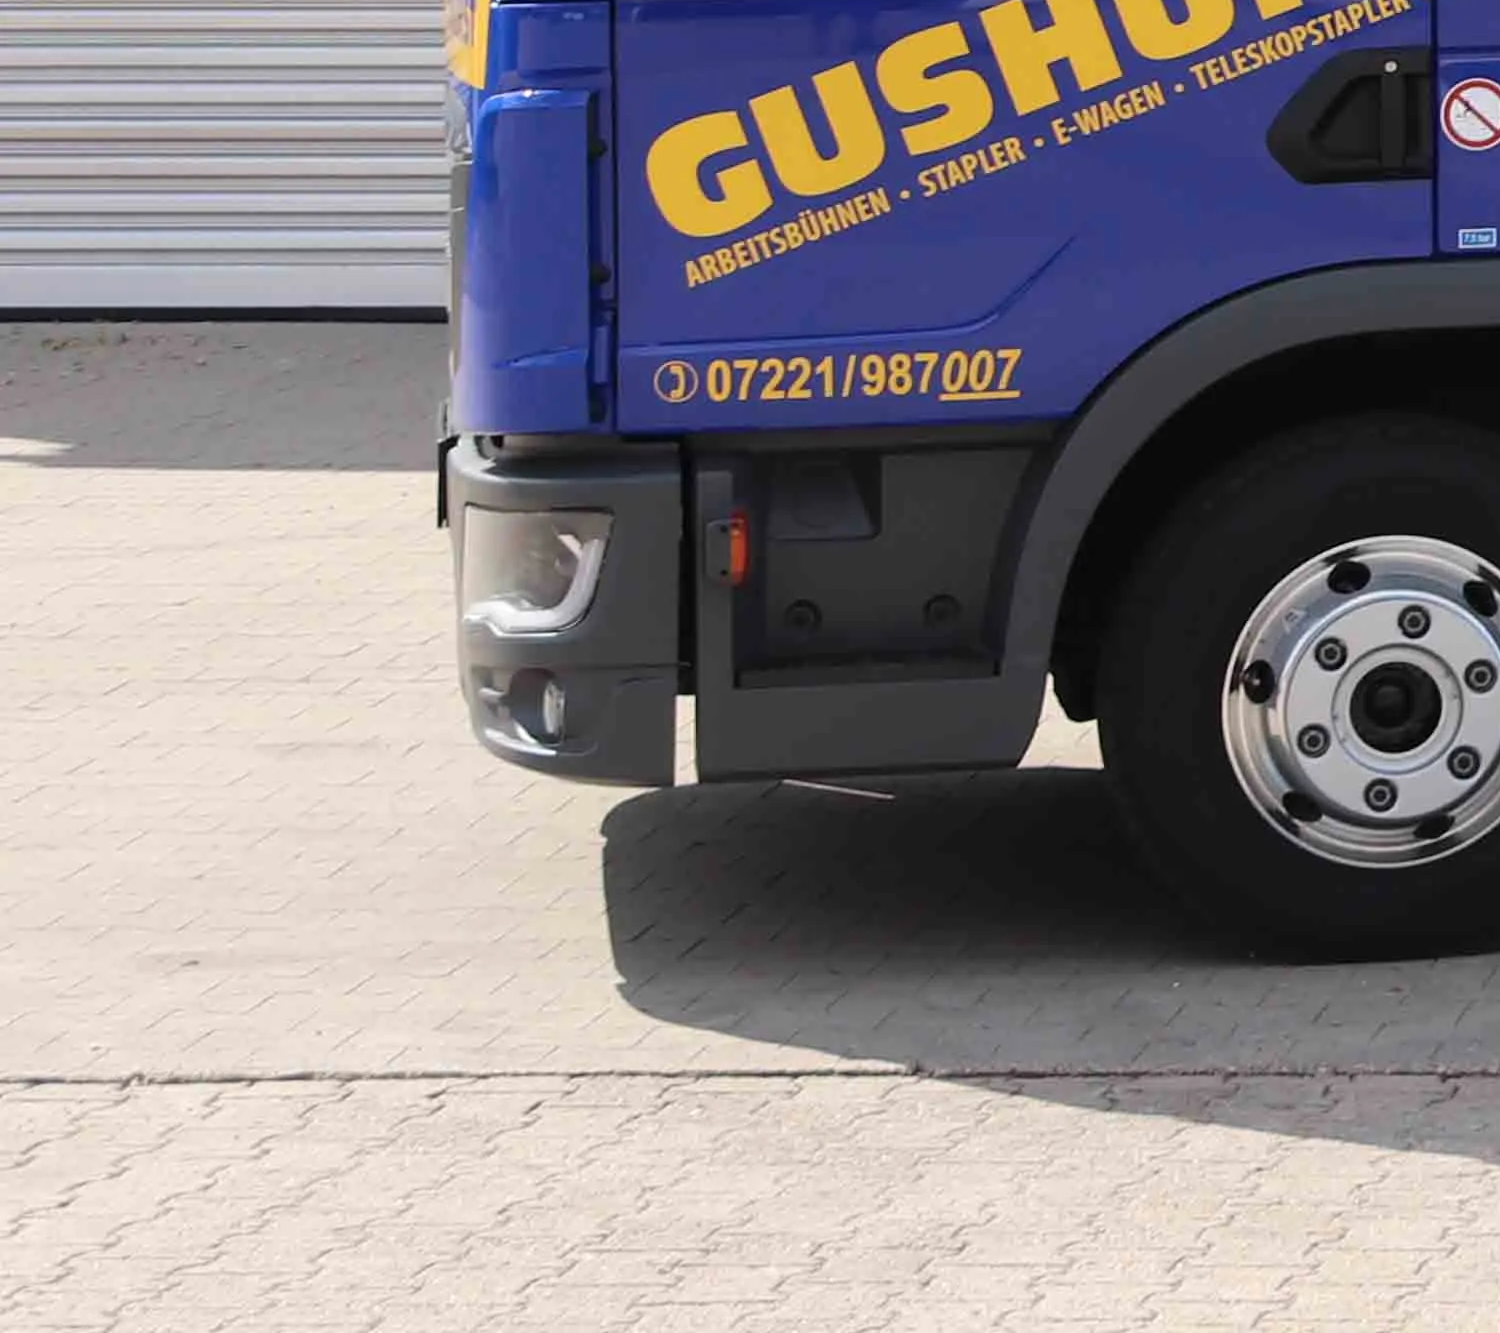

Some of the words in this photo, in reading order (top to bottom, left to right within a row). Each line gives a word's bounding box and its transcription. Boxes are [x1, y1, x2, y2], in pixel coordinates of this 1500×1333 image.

[684, 187, 892, 288] ARBEITSBÜHNEN
[917, 136, 1027, 198] STAPLER
[1051, 81, 1166, 145] E-WAGEN
[706, 348, 1022, 402] 07221/987007
